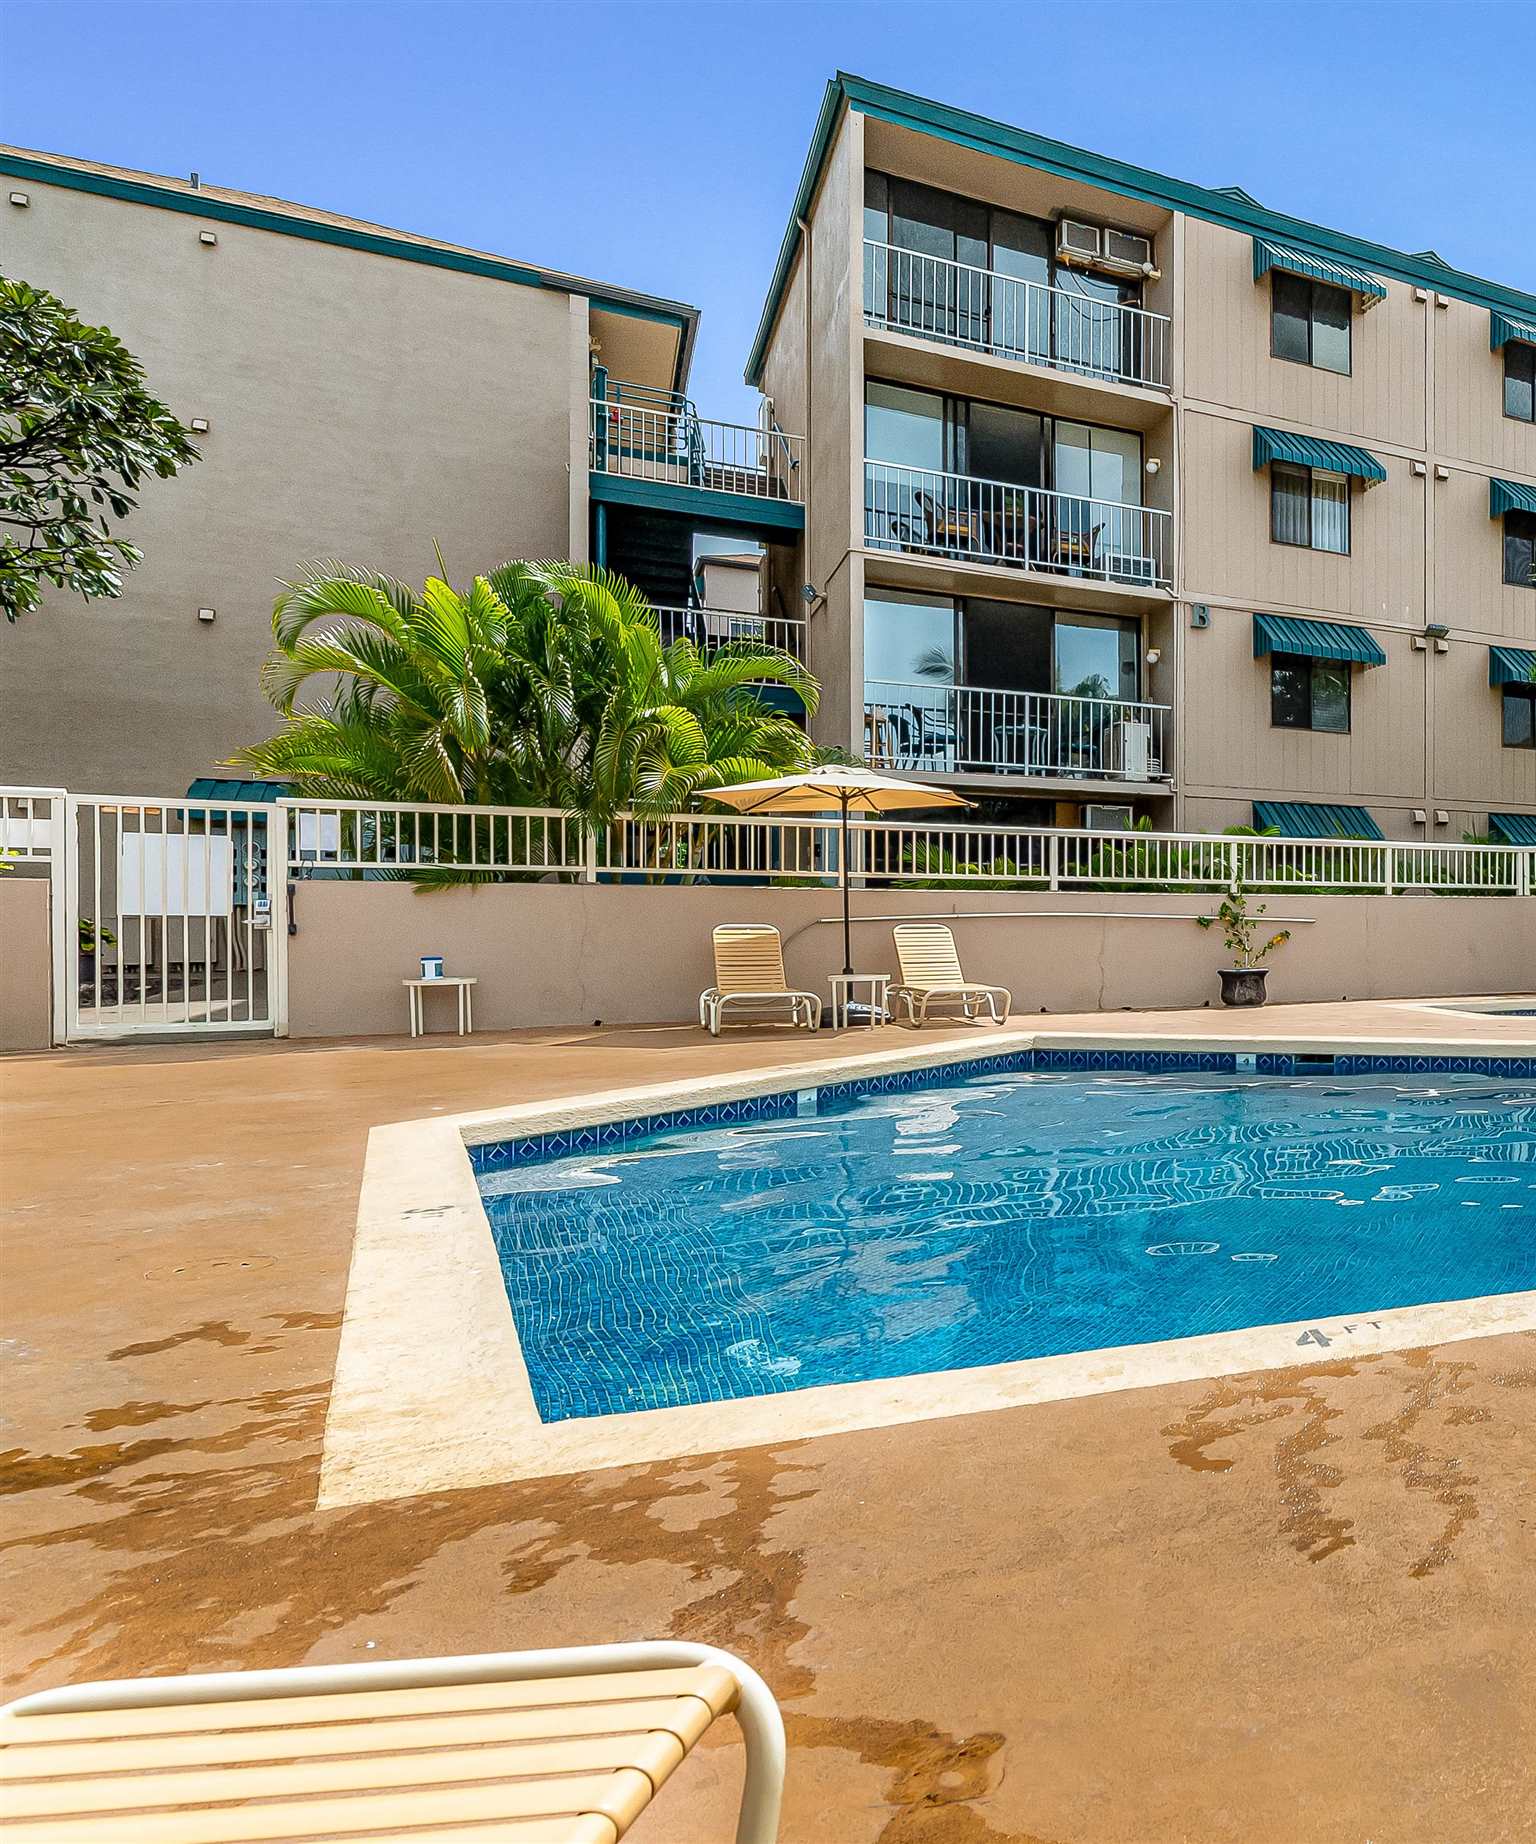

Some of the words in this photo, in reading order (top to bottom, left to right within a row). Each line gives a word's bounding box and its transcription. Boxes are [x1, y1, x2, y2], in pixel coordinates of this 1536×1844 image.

[1191, 603, 1209, 629] B
[1296, 1328, 1333, 1347] 4
[1343, 1320, 1382, 1334] FT
